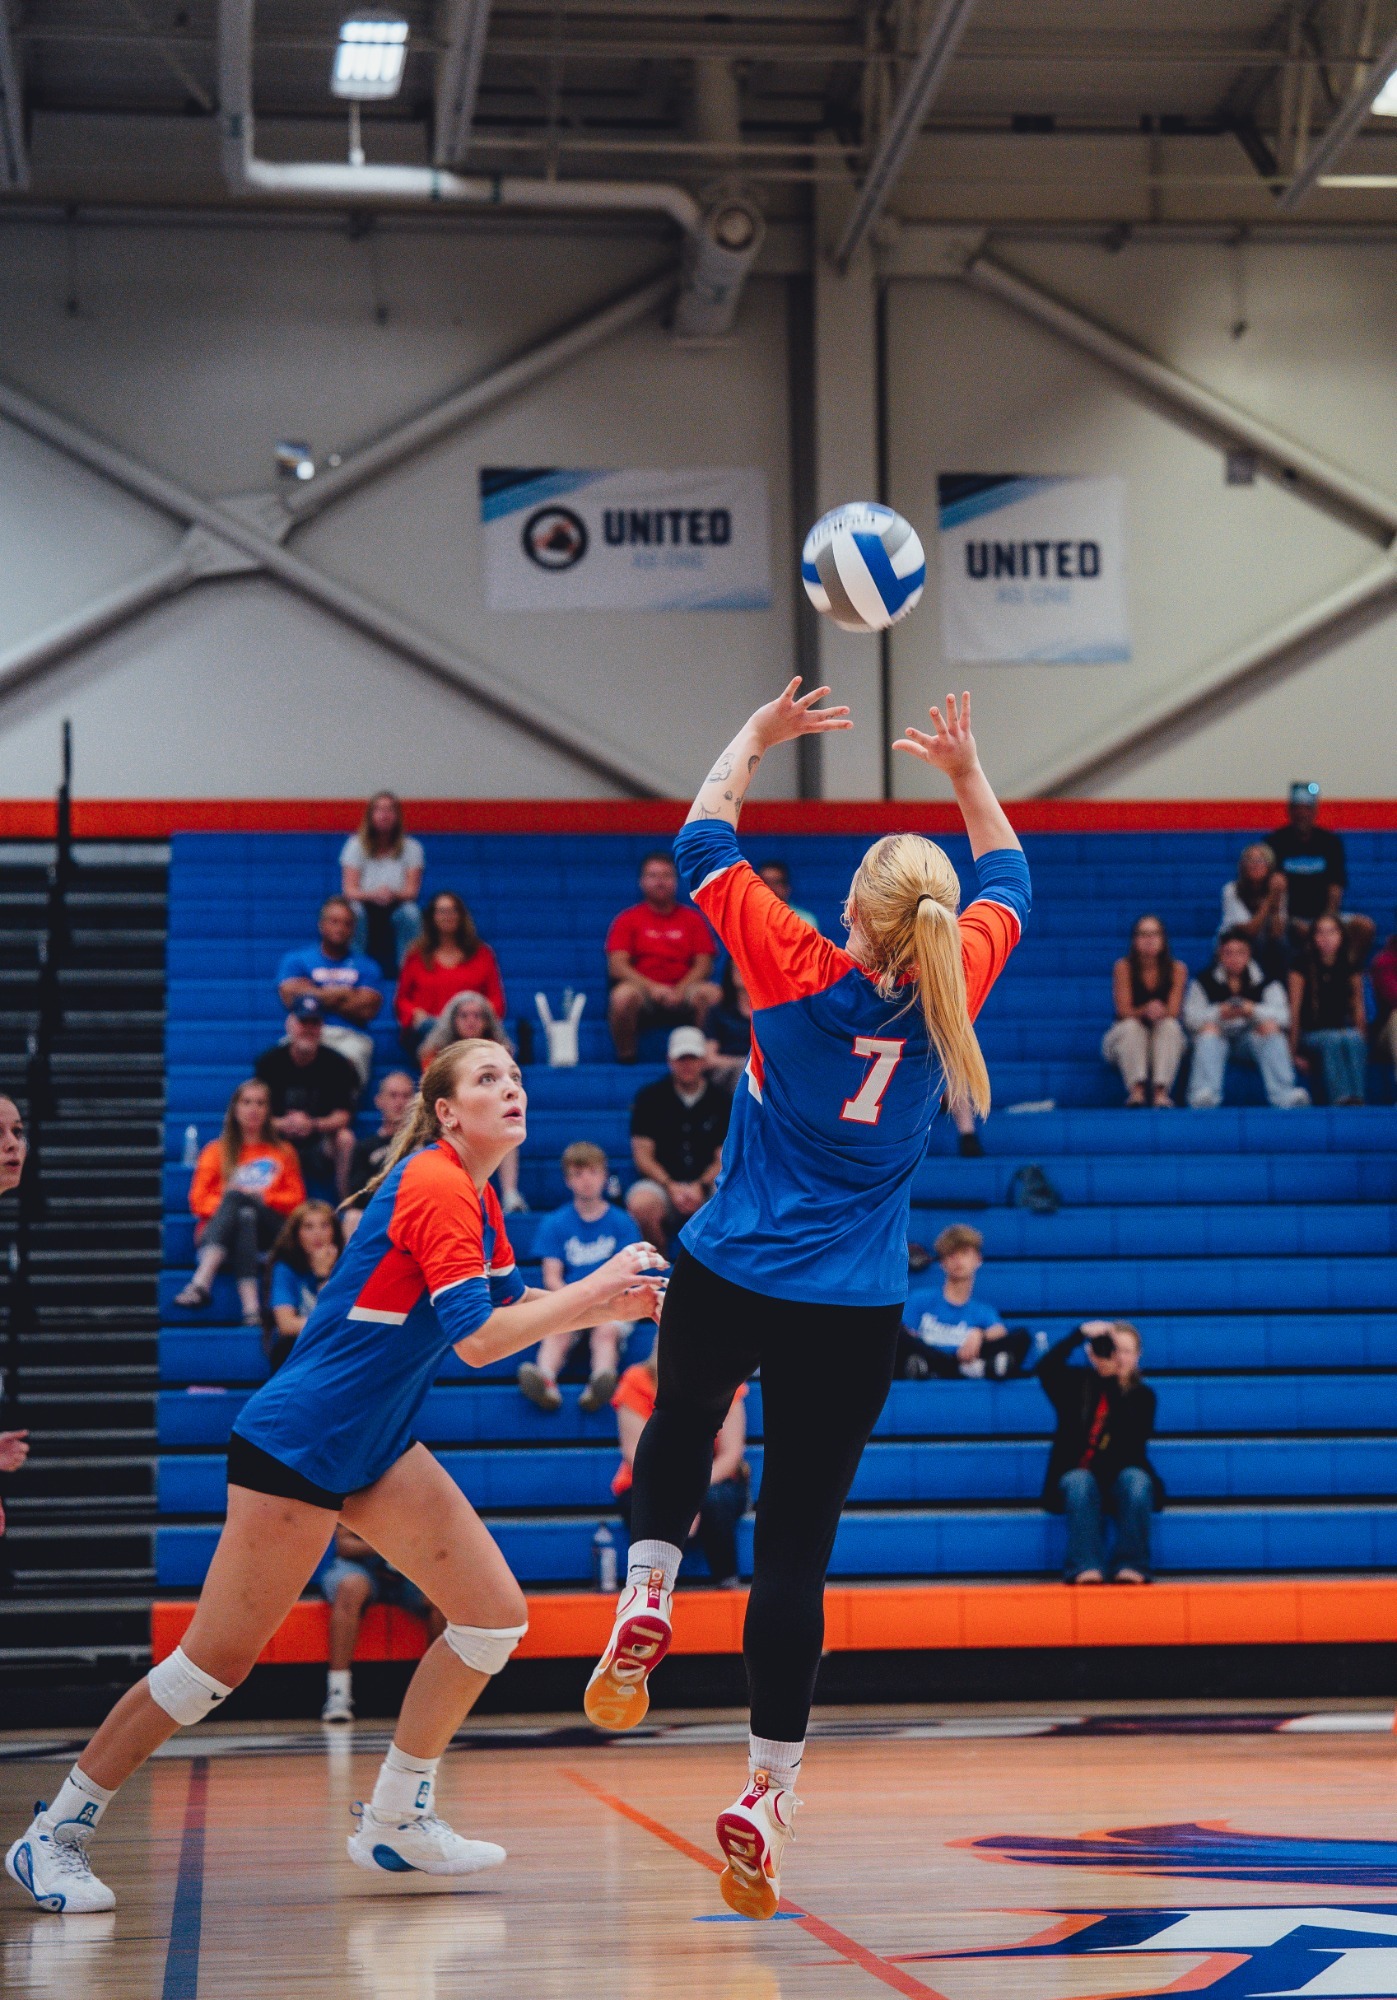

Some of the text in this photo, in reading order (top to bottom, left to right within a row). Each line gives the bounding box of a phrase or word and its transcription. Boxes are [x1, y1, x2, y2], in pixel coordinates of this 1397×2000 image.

[604, 508, 731, 546] UNITED
[965, 540, 1102, 580] UNITED
[839, 1035, 907, 1126] 7
